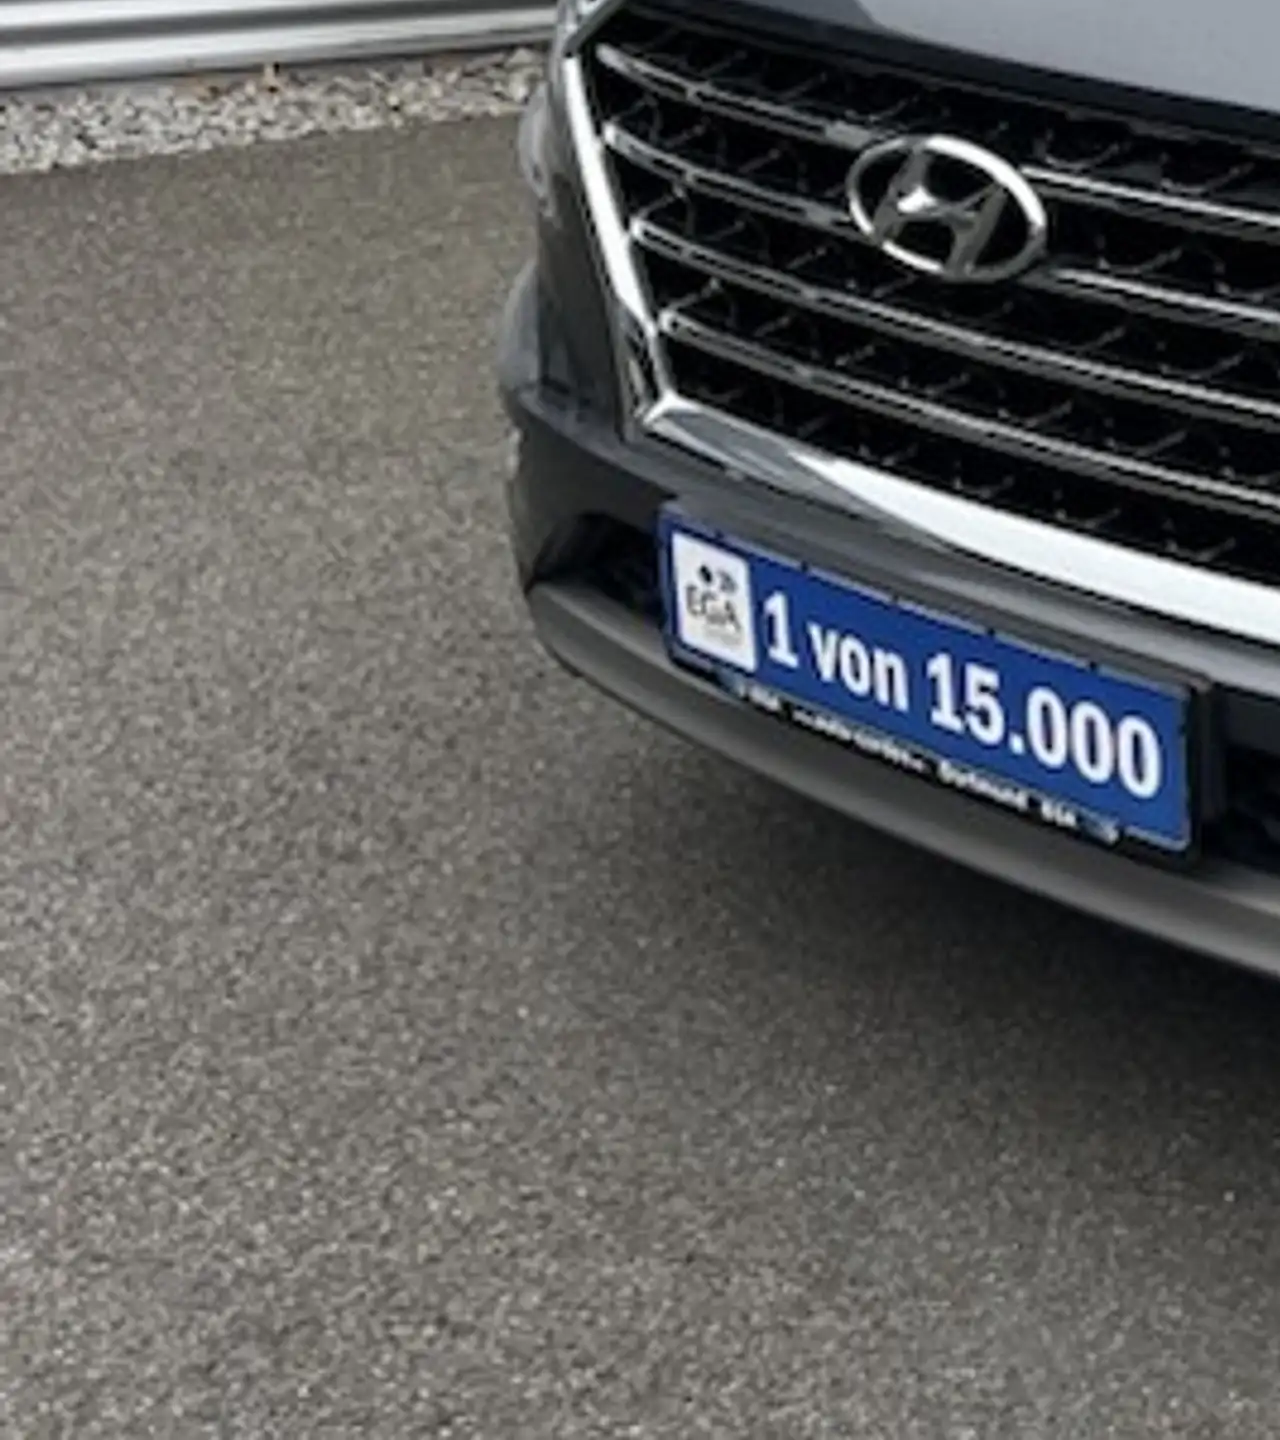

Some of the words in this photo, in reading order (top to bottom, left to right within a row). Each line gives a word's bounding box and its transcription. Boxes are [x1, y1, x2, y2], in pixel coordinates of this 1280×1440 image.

[685, 584, 742, 633] EGA
[764, 591, 798, 668] 1
[808, 621, 910, 712] von
[927, 652, 1163, 800] 15.000
